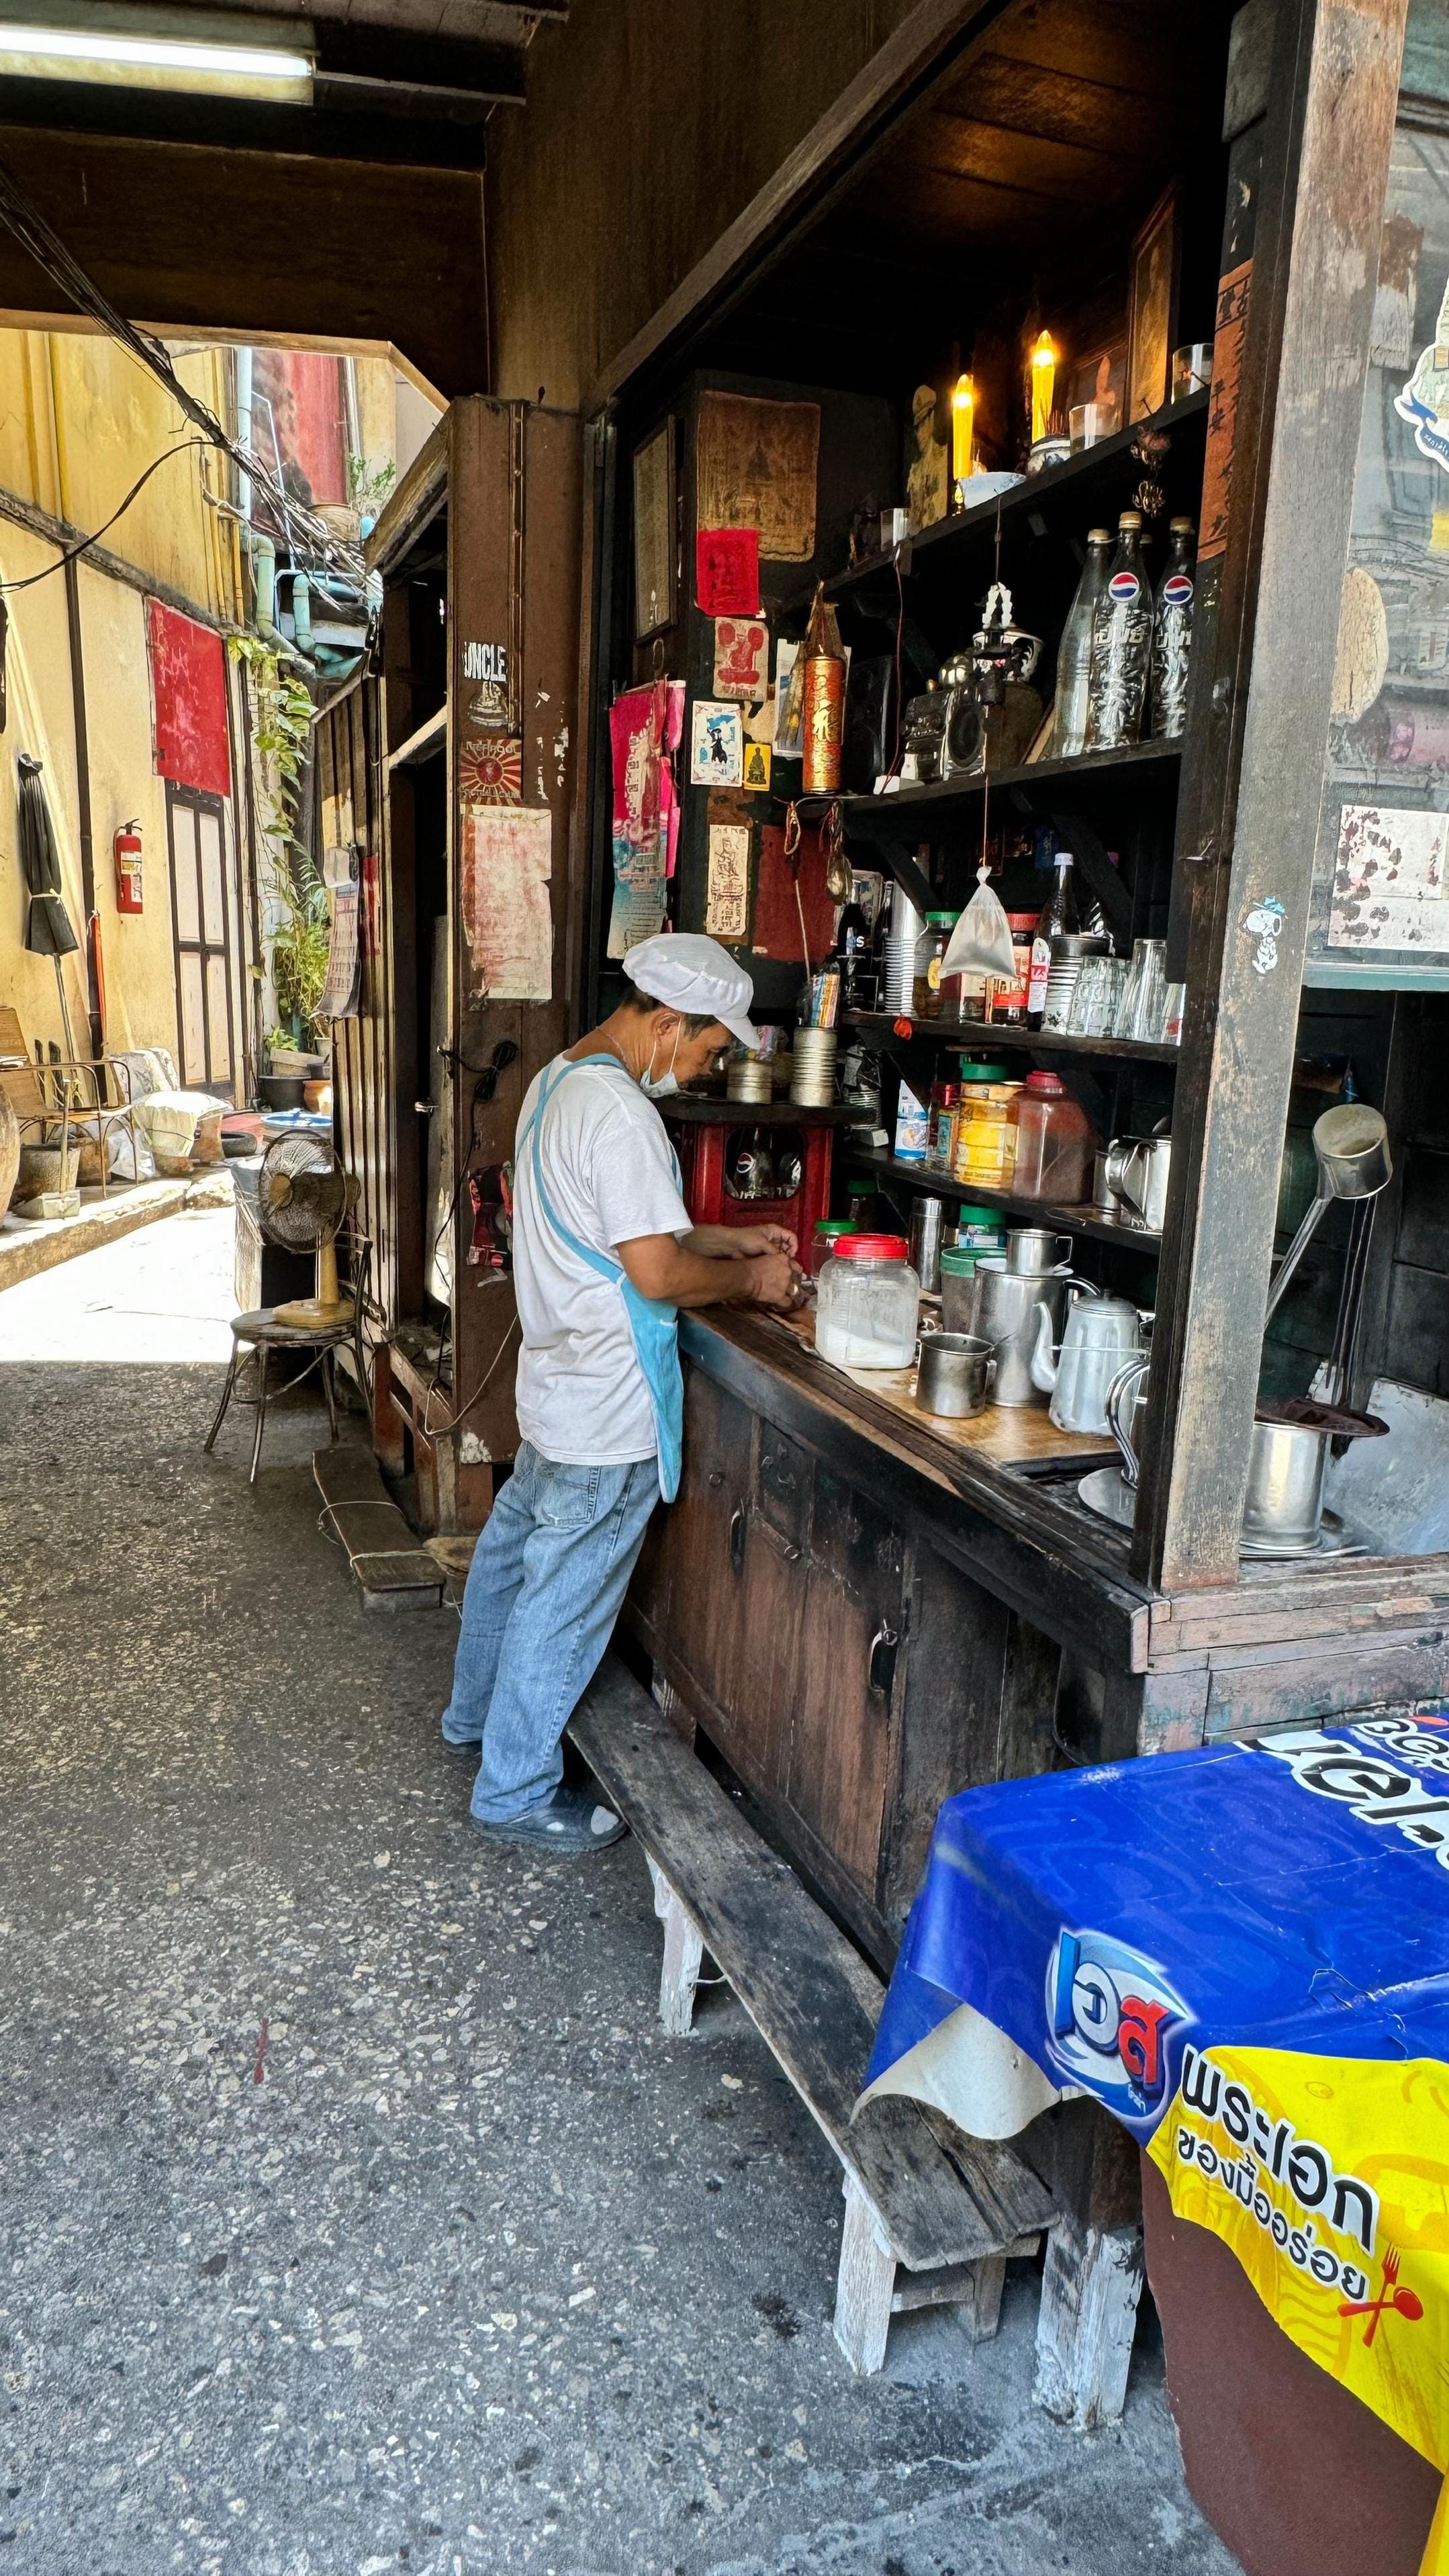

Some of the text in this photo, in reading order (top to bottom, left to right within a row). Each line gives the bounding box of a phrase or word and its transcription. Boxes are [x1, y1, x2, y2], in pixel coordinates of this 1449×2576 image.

[464, 641, 507, 683] UNCLE
[1054, 1931, 1170, 2086] เอส
[1178, 2128, 1365, 2300] ของมื้ออร่อย
[1182, 2049, 1375, 2252] พระเอก
